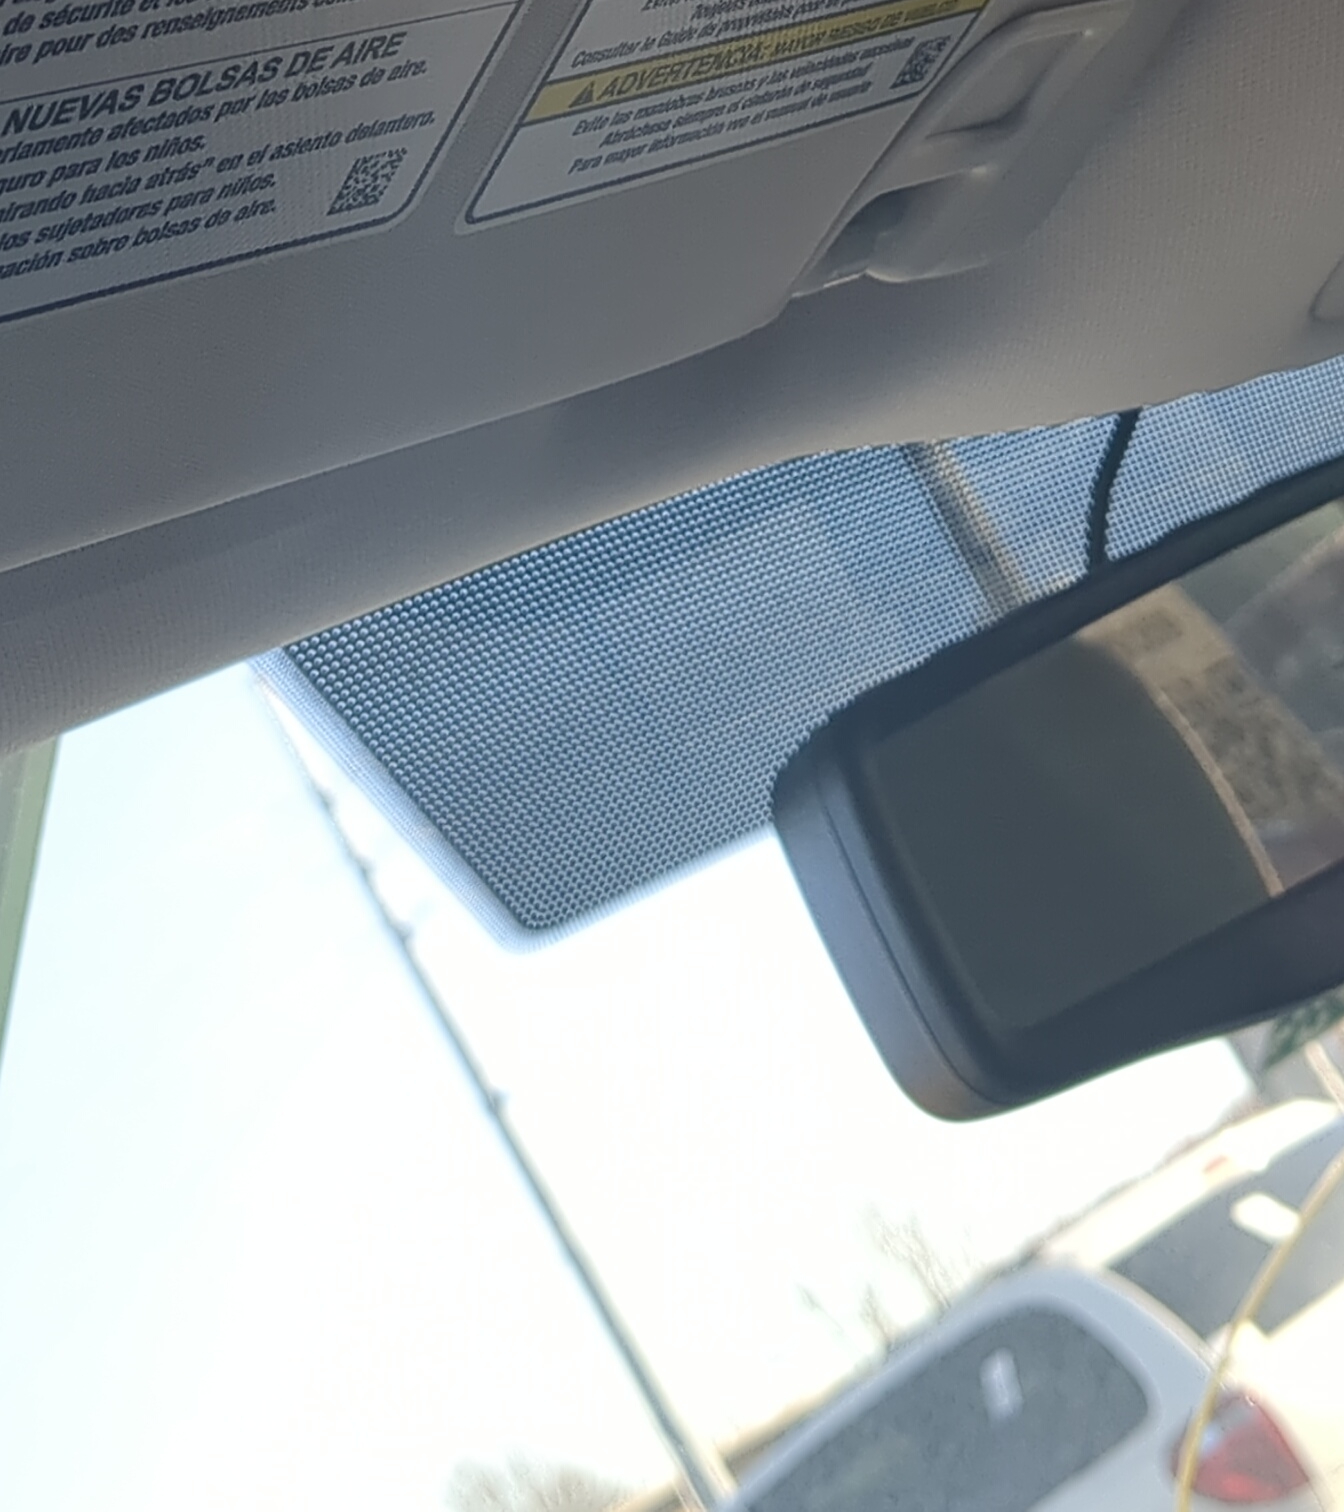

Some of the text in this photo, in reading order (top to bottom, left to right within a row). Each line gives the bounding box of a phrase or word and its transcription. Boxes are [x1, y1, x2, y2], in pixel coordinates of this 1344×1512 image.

[1, 10, 36, 36] de
[32, 32, 95, 64] pour
[95, 23, 139, 48] des
[0, 83, 144, 136] NUEVAS
[147, 56, 283, 106] BOLSAS
[283, 44, 335, 79] DE
[329, 30, 407, 69] AIRE
[601, 42, 770, 97] ADVERTENCIA:
[45, 156, 103, 188] para
[104, 148, 141, 172] los
[142, 134, 206, 162] niños.
[34, 199, 163, 244] sujetadores
[161, 186, 215, 217] para
[215, 172, 276, 200] niños.
